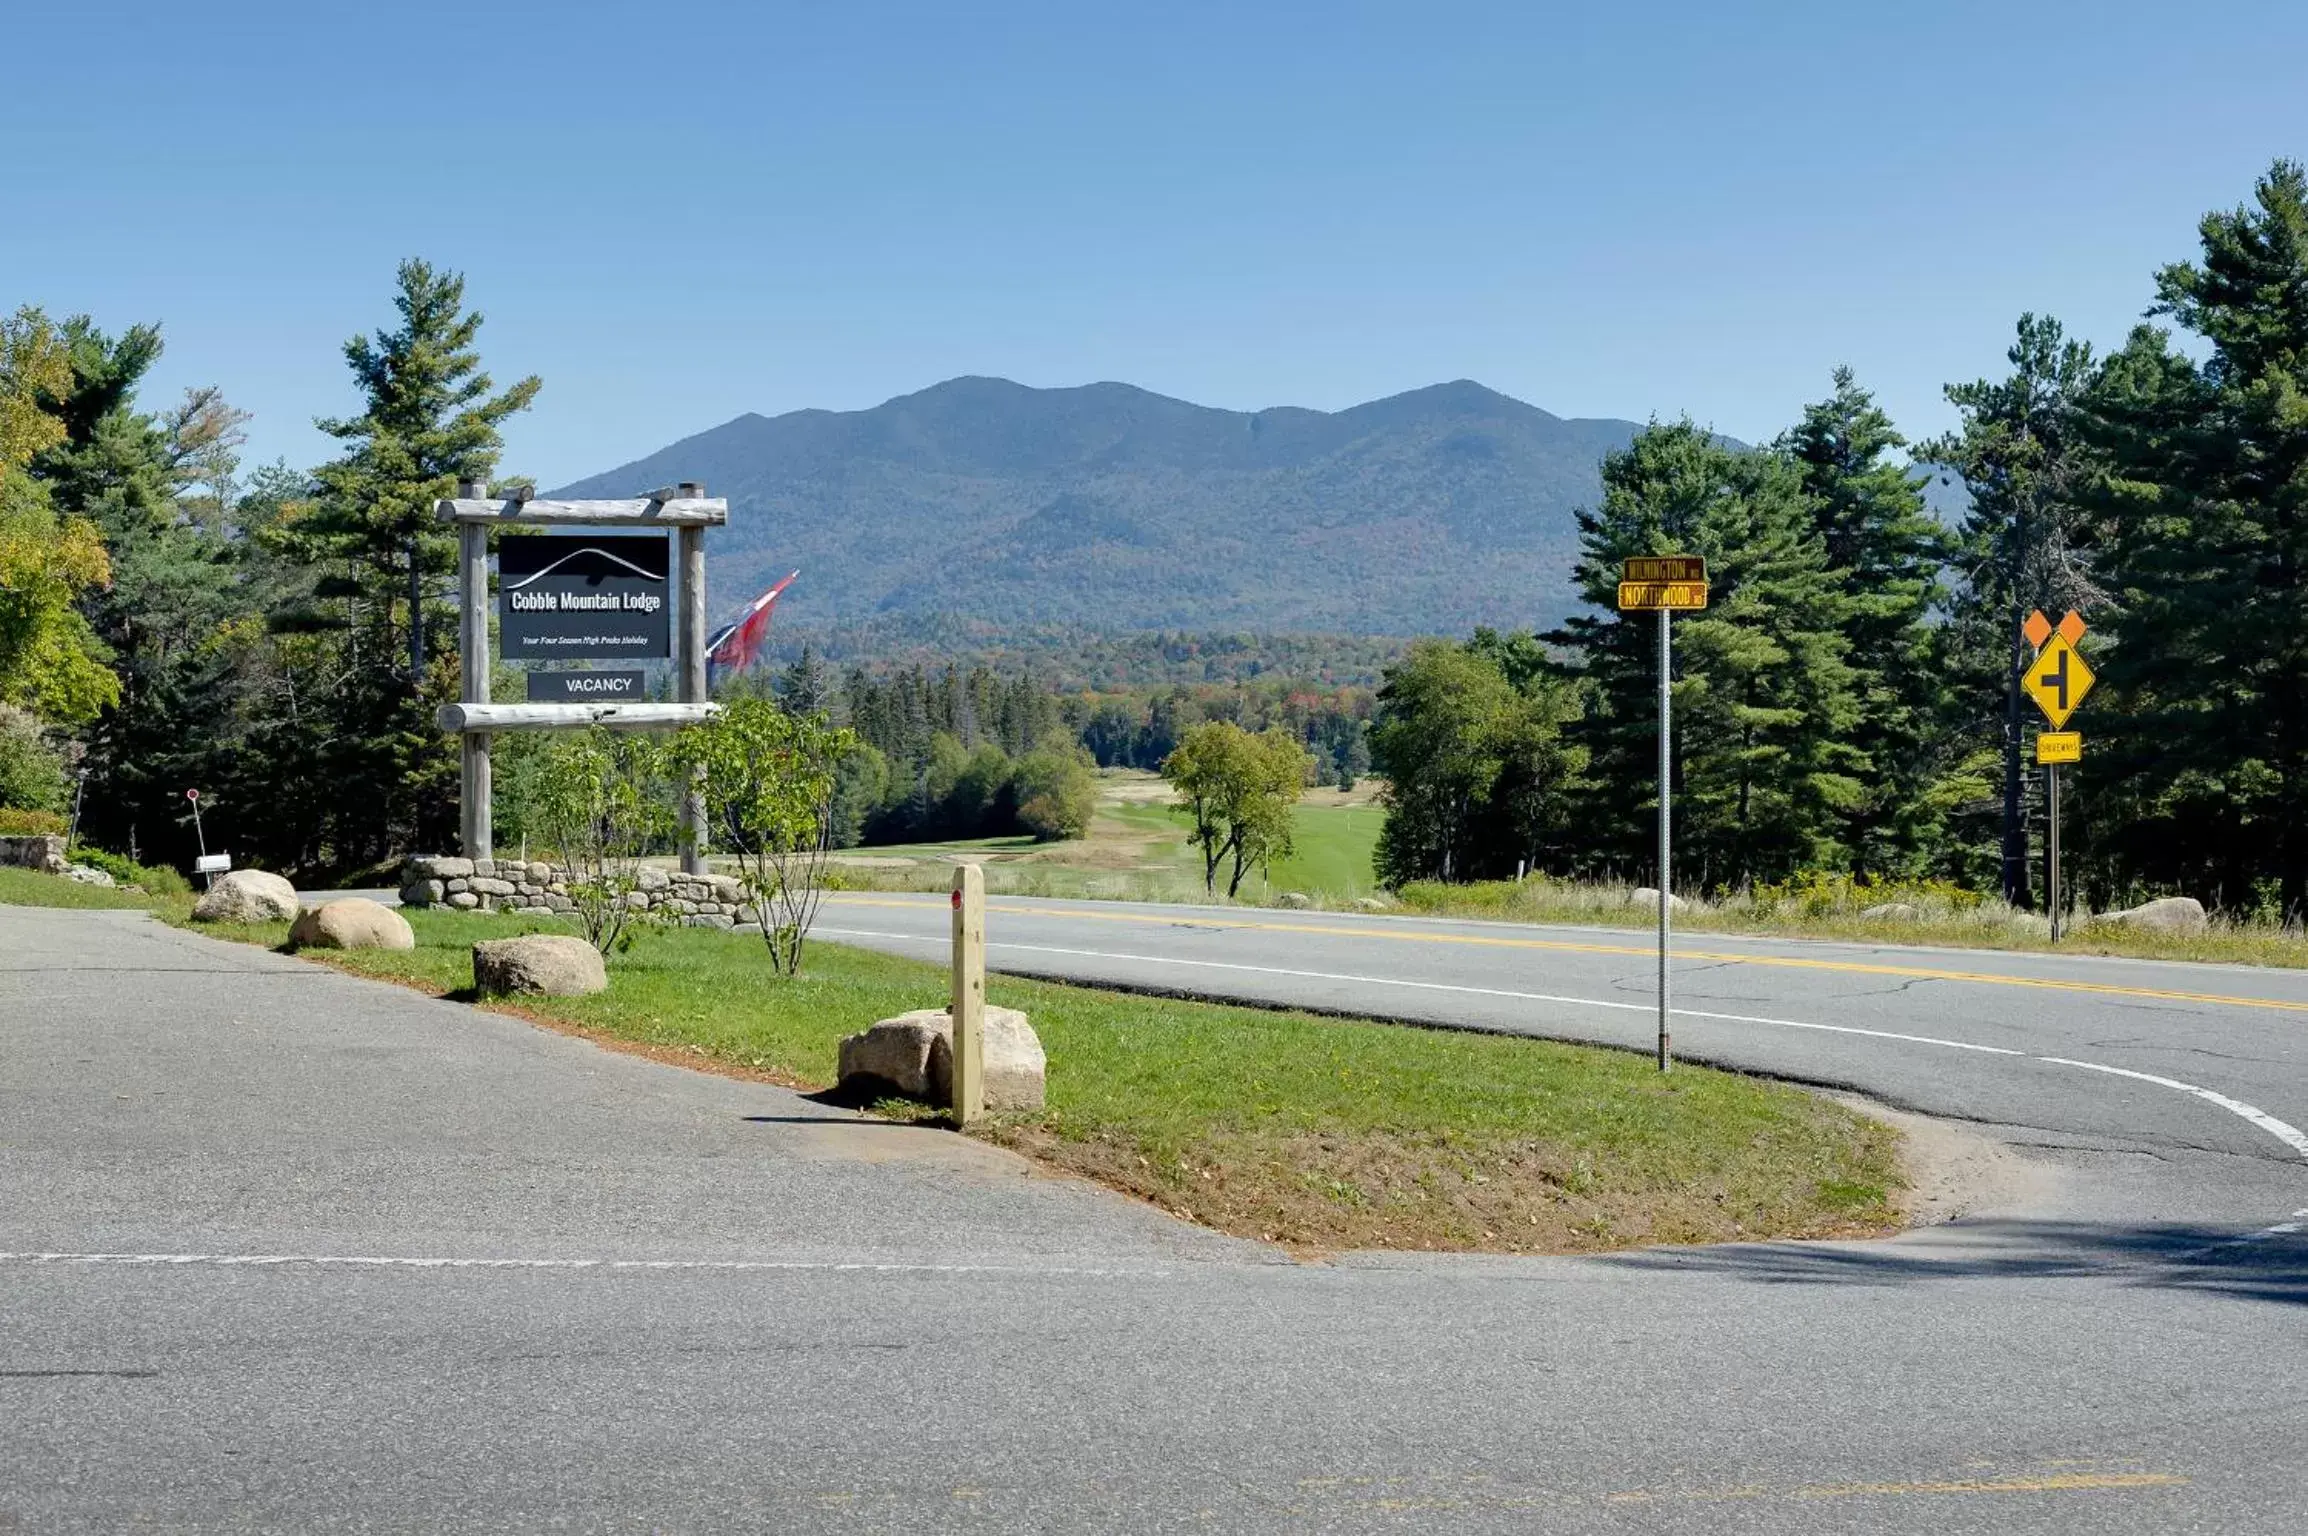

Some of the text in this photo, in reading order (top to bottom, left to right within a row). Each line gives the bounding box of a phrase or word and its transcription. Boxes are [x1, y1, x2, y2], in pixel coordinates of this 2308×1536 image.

[1628, 560, 1686, 579] WILMINGTON
[512, 592, 660, 612] Cobble Mountain Lodge
[1625, 586, 1690, 605] NORTHWOOD
[522, 636, 648, 646] Your Four Season High Peaks Holiday
[566, 678, 632, 692] VACANCY
